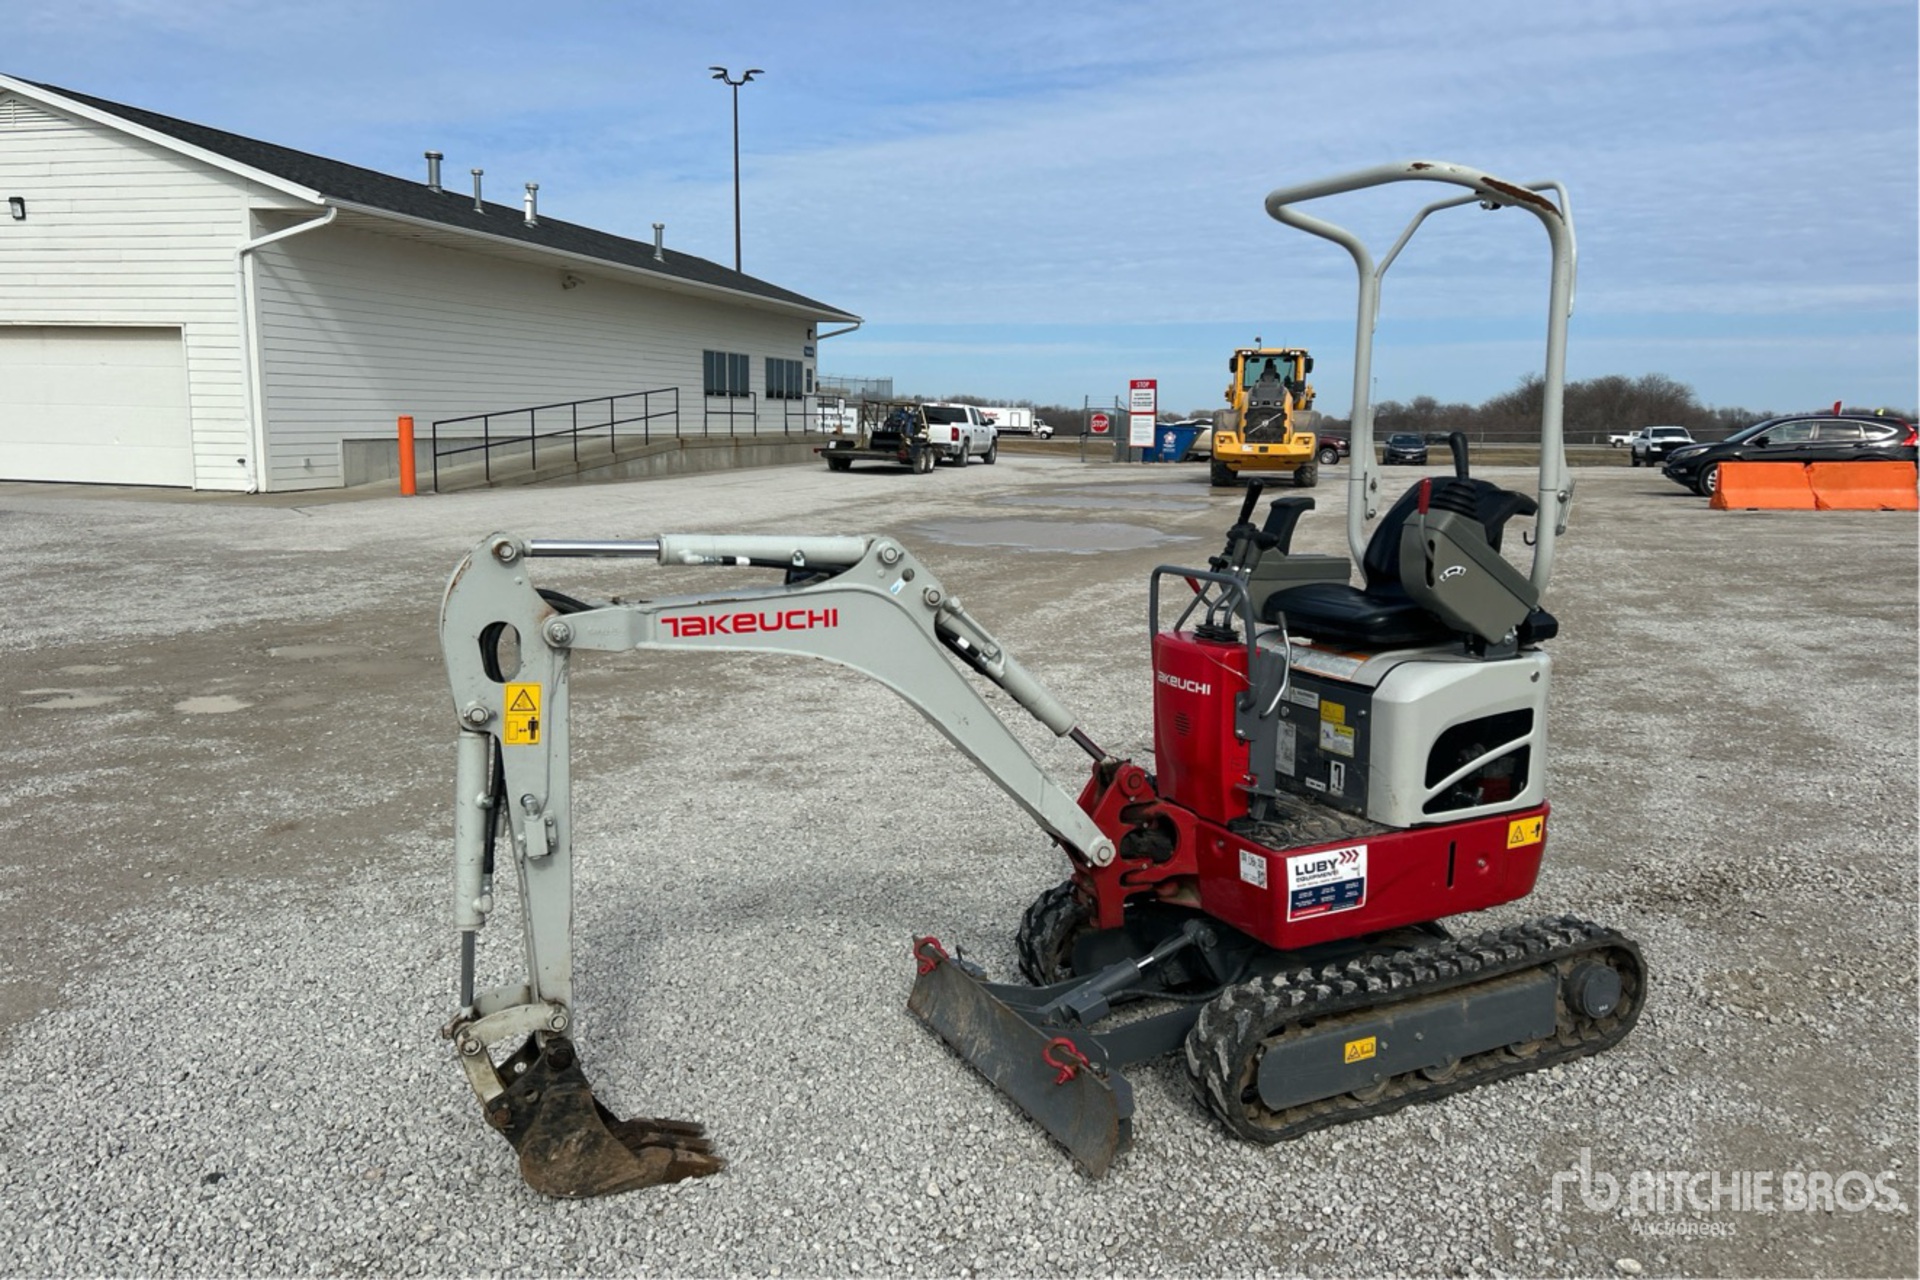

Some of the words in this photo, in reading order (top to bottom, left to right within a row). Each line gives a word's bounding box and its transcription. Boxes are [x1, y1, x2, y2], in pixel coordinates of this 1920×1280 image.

[1092, 420, 1108, 428] STOP
[661, 608, 838, 638] TAKEUCHI
[1157, 670, 1211, 696] AKEUCHI
[1295, 858, 1338, 876] LUBY
